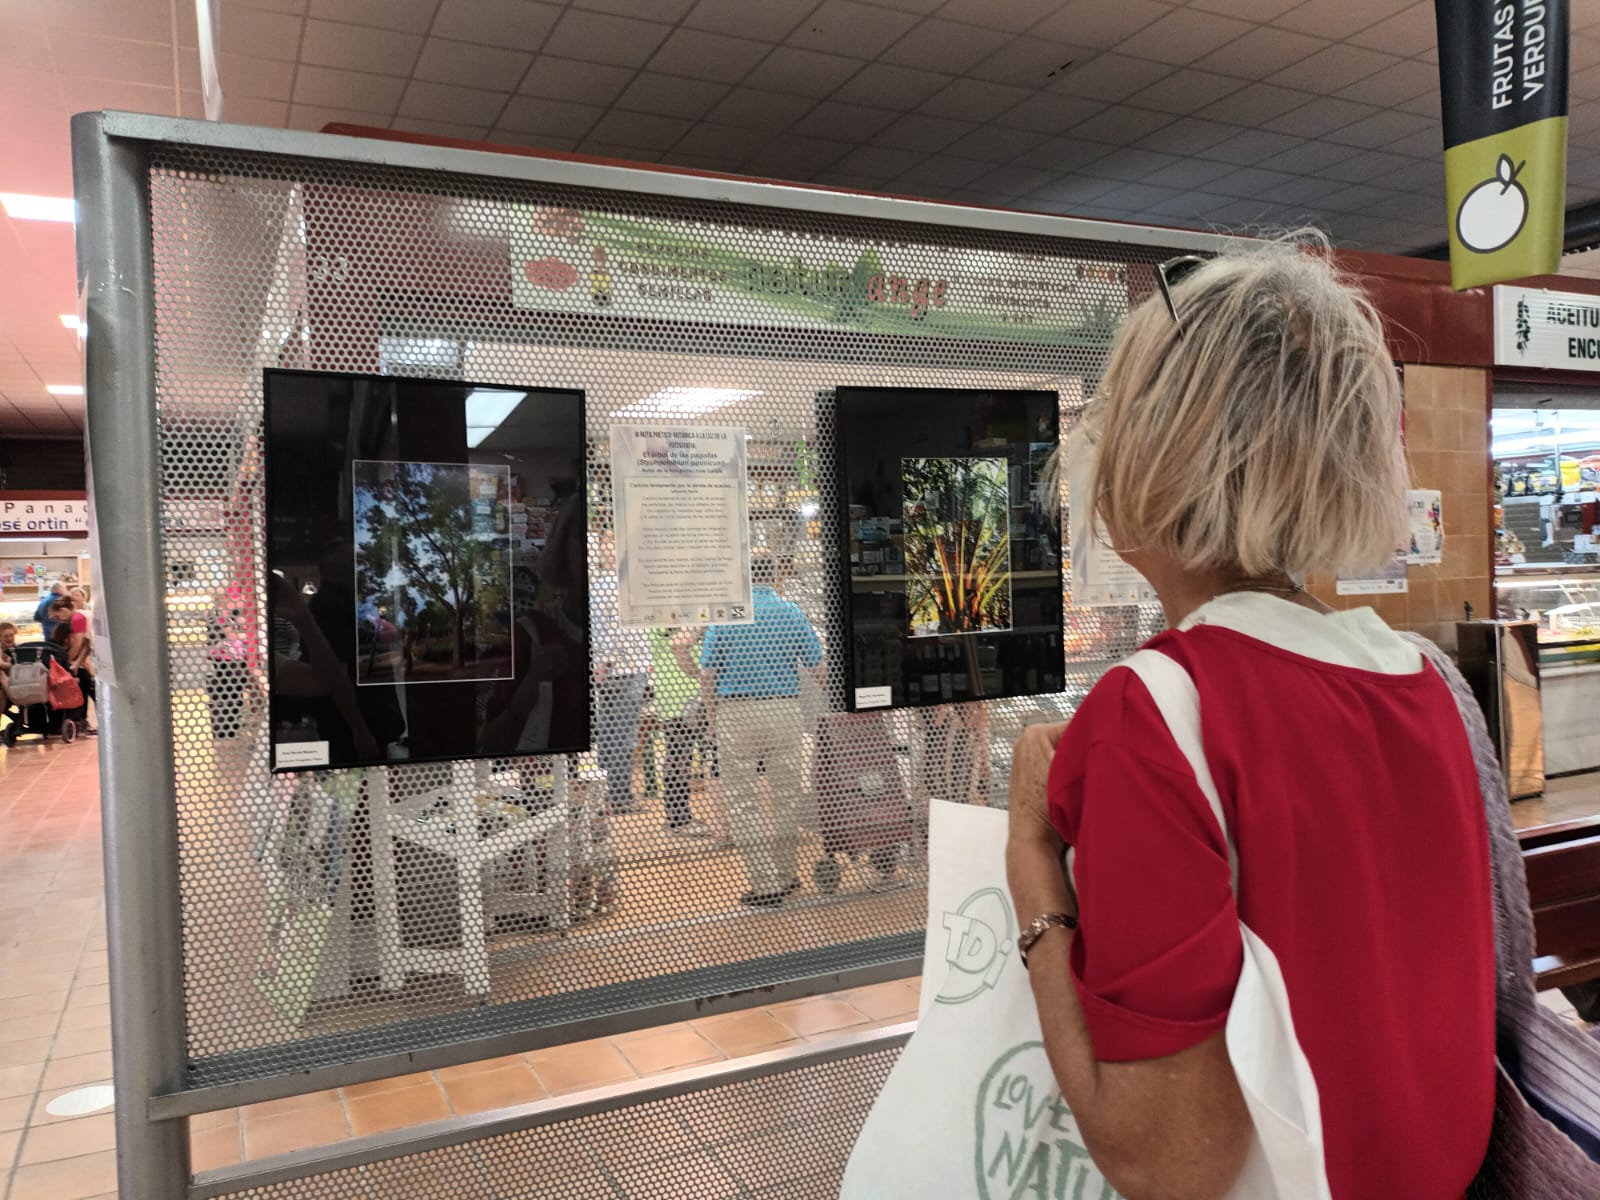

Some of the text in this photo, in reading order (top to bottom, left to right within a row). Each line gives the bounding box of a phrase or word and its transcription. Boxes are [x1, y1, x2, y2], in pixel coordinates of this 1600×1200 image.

[1491, 4, 1515, 109] FRUTAS
[0, 517, 69, 530] sé ortin
[993, 1074, 1073, 1132] LOVE
